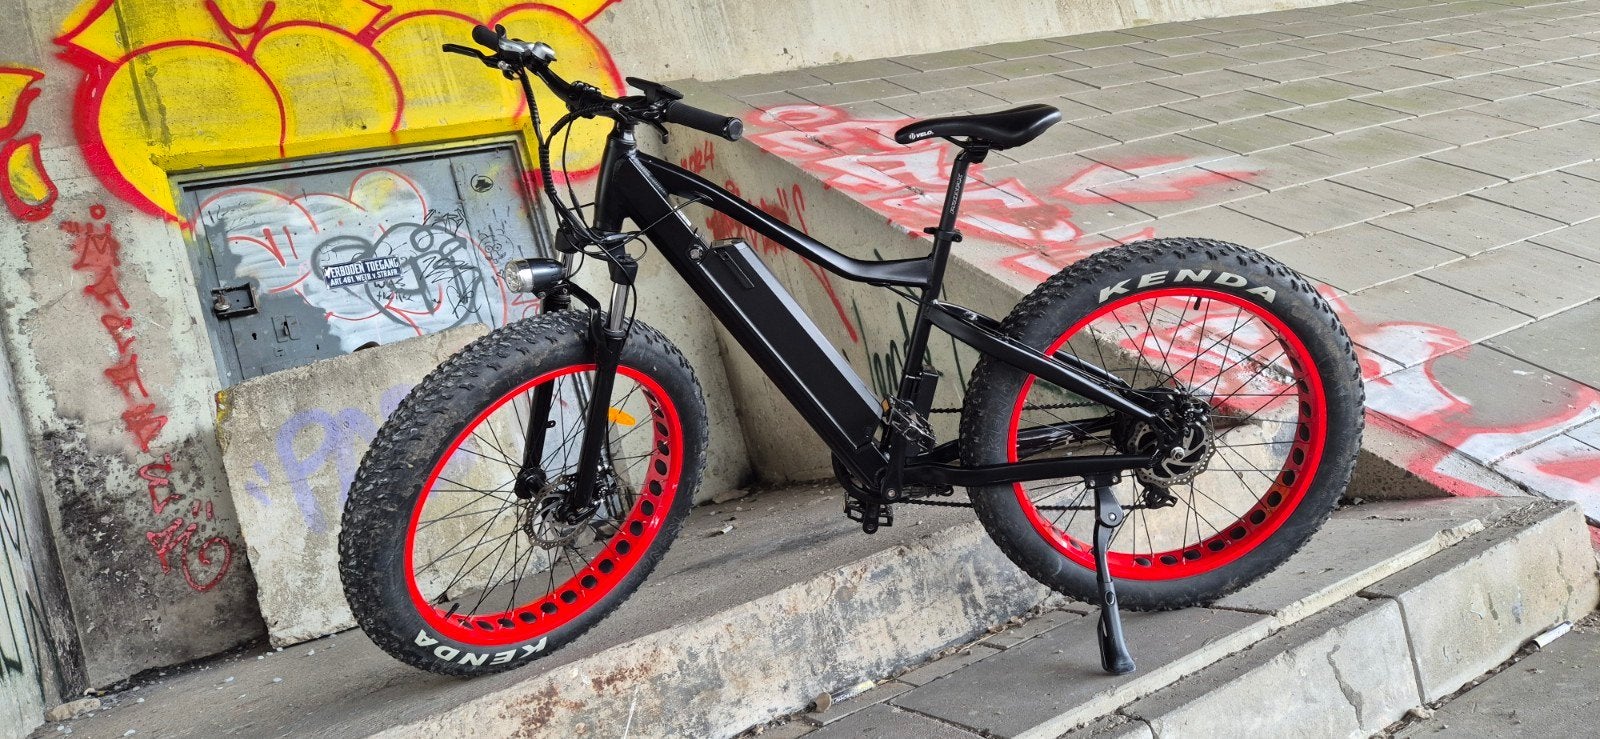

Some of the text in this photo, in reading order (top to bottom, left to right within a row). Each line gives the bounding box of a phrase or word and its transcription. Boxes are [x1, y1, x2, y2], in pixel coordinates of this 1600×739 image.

[326, 258, 399, 278] VERBODEN TOEGANG
[1098, 269, 1277, 304] KENDA
[414, 628, 548, 666] KENDA
